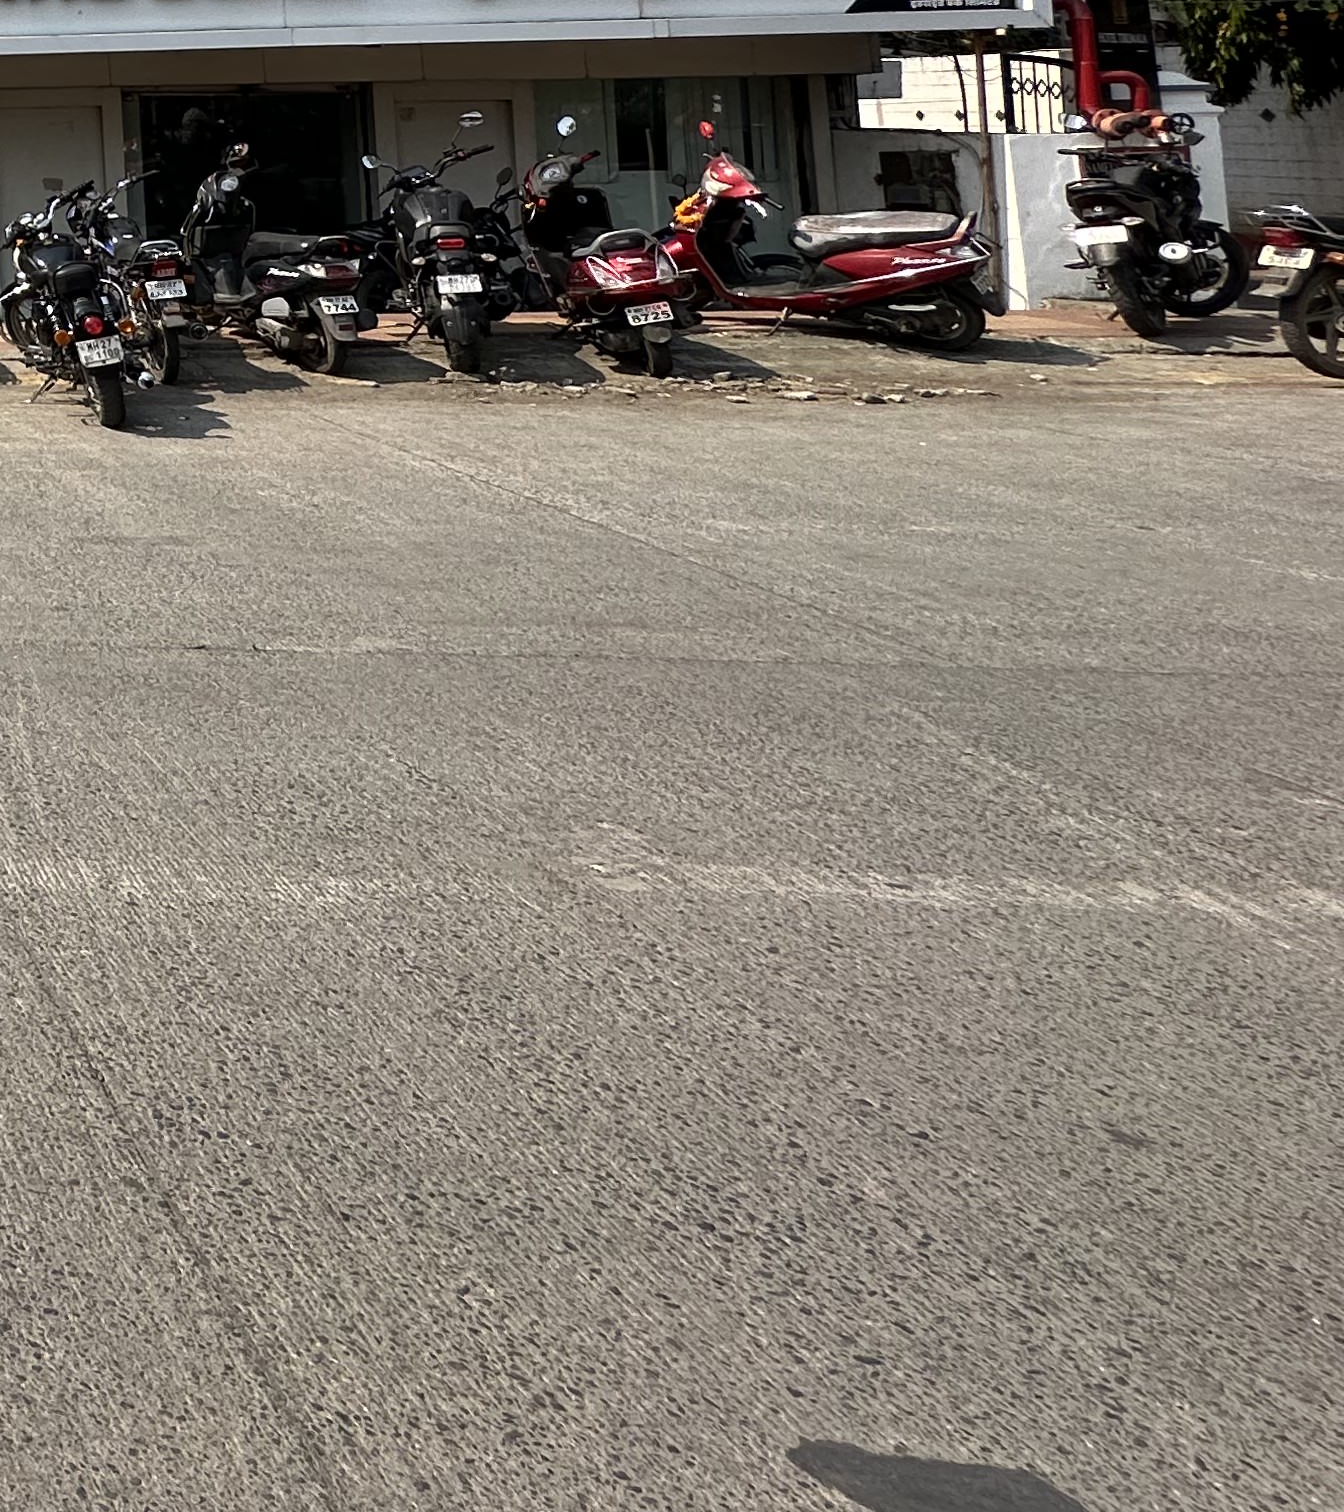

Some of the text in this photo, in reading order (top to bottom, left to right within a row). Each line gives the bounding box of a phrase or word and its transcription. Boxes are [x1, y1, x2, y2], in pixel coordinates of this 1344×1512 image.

[324, 303, 357, 313] 7744
[631, 310, 671, 324] 8725
[99, 338, 112, 349] 27
